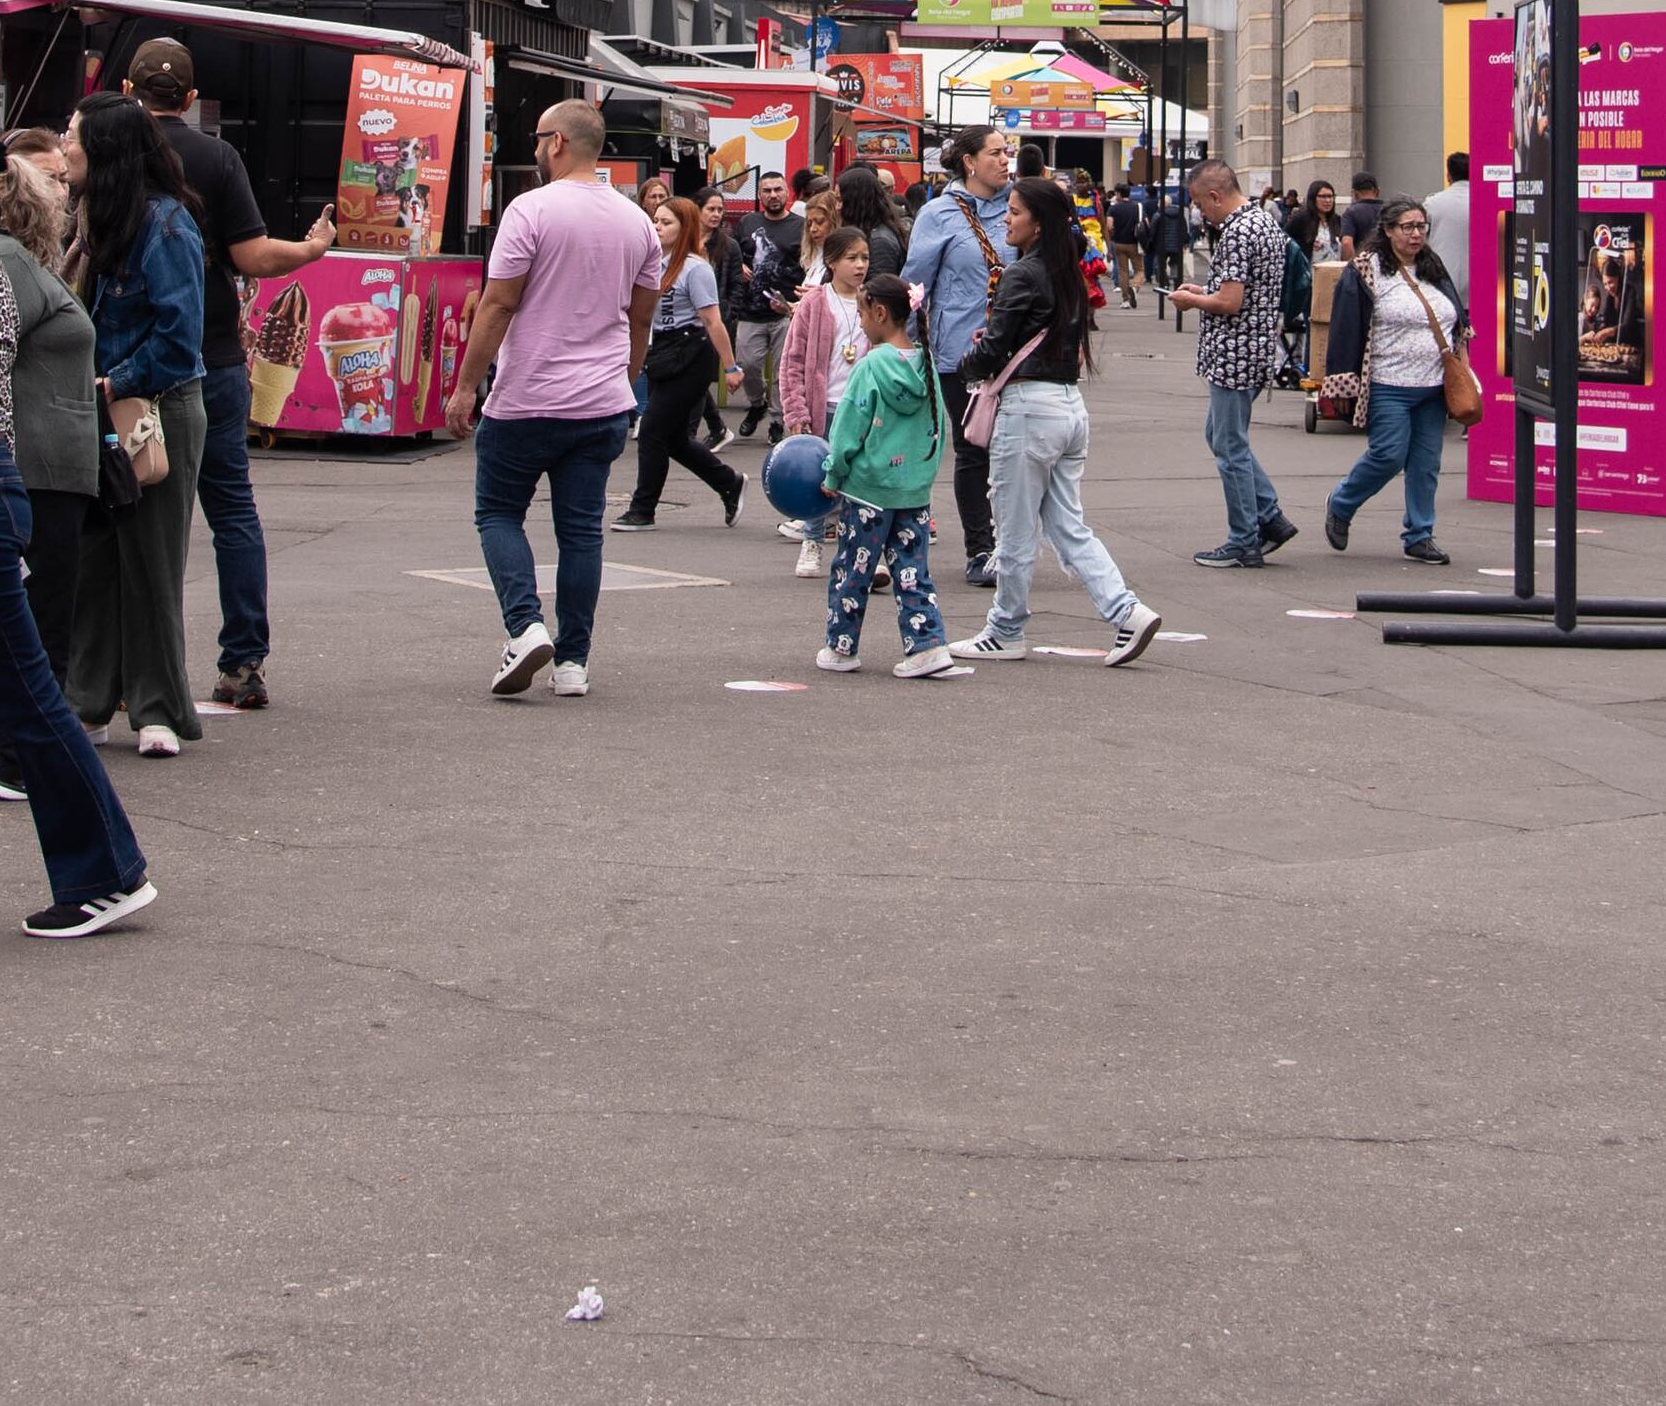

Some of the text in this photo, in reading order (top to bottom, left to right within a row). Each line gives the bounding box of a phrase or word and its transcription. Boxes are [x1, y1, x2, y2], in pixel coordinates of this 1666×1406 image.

[360, 69, 454, 99] Dukan
[359, 92, 451, 110] PALETA PARA PERROS
[1584, 91, 1600, 106] LAS
[1602, 90, 1639, 106] MARCAS
[1588, 111, 1624, 127] POSIBLE
[1598, 130, 1612, 149] DEL
[1615, 130, 1643, 149] HOGAR
[340, 351, 380, 377] ALOHA
